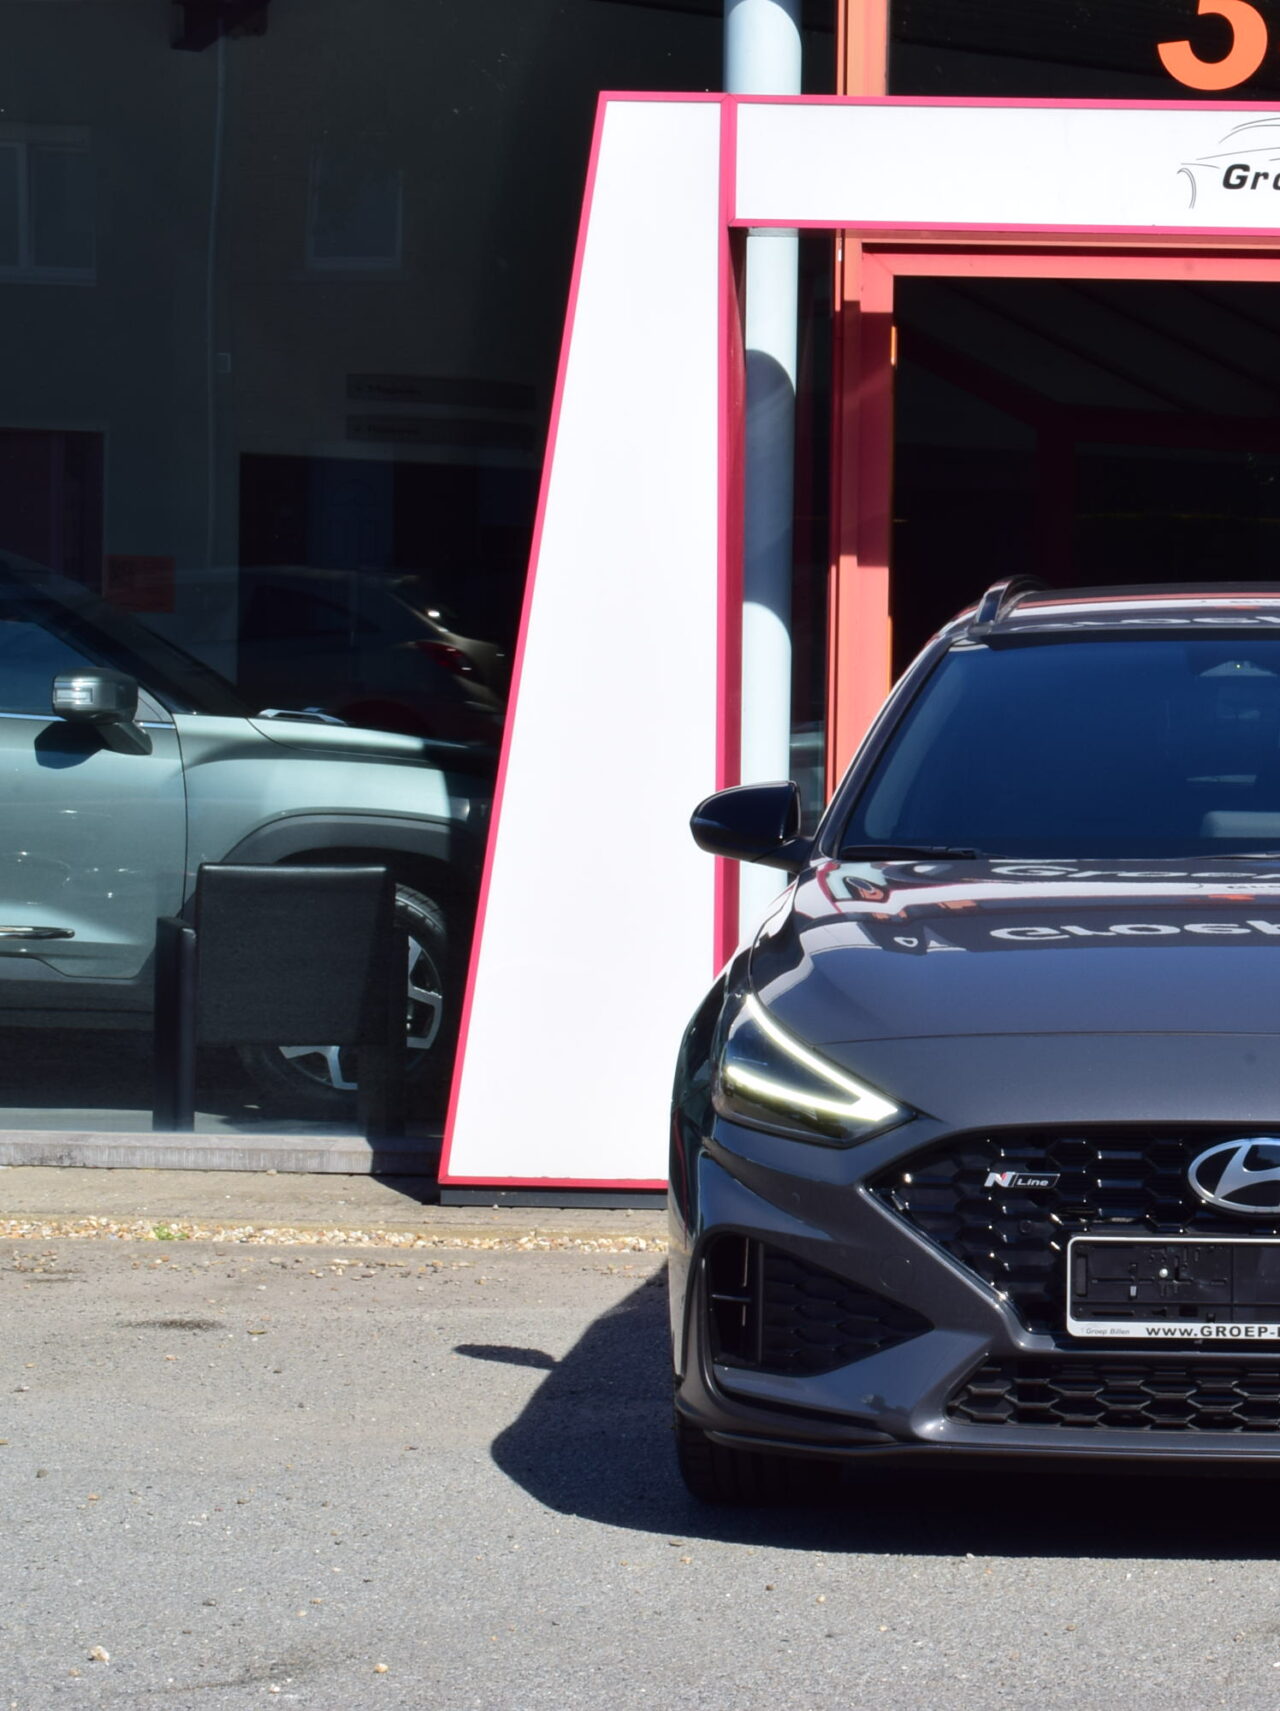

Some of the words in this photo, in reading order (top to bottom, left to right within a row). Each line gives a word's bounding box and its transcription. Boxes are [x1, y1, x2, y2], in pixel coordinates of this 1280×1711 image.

[984, 1171, 1015, 1187] N
[1017, 1178, 1049, 1187] Line
[1086, 1328, 1107, 1336] Groep
